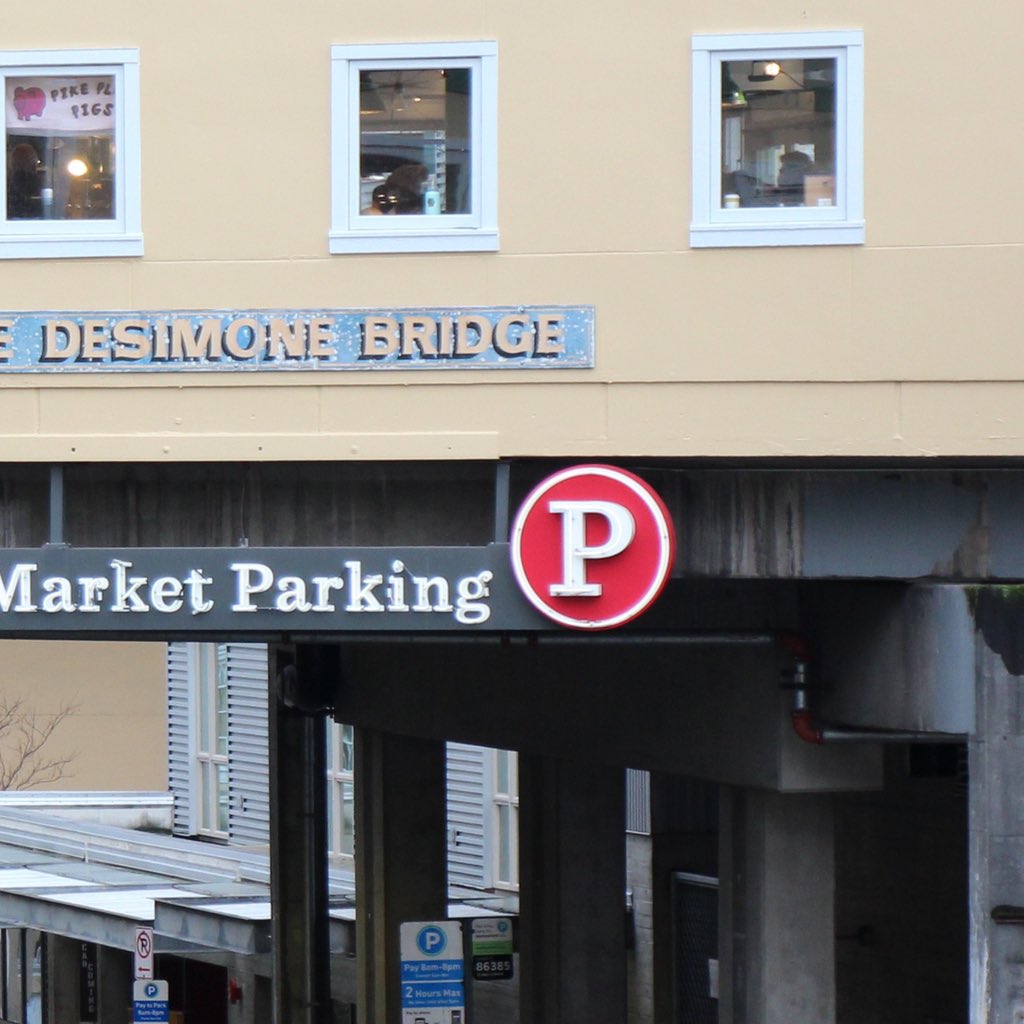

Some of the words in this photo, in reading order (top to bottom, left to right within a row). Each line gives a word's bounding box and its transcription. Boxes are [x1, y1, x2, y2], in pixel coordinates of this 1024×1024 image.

[51, 83, 88, 101] PIKE
[71, 103, 114, 118] PIGS
[39, 316, 334, 361] DESIMONE
[358, 312, 566, 359] BRIDGE
[548, 500, 636, 597] P
[230, 560, 492, 624] Parking
[425, 932, 440, 950] P
[404, 964, 419, 973] Pay
[476, 961, 510, 971] 86385
[148, 986, 156, 996] P
[405, 986, 413, 998] 2
[416, 989, 441, 998] Hours
[443, 989, 461, 997] Max
